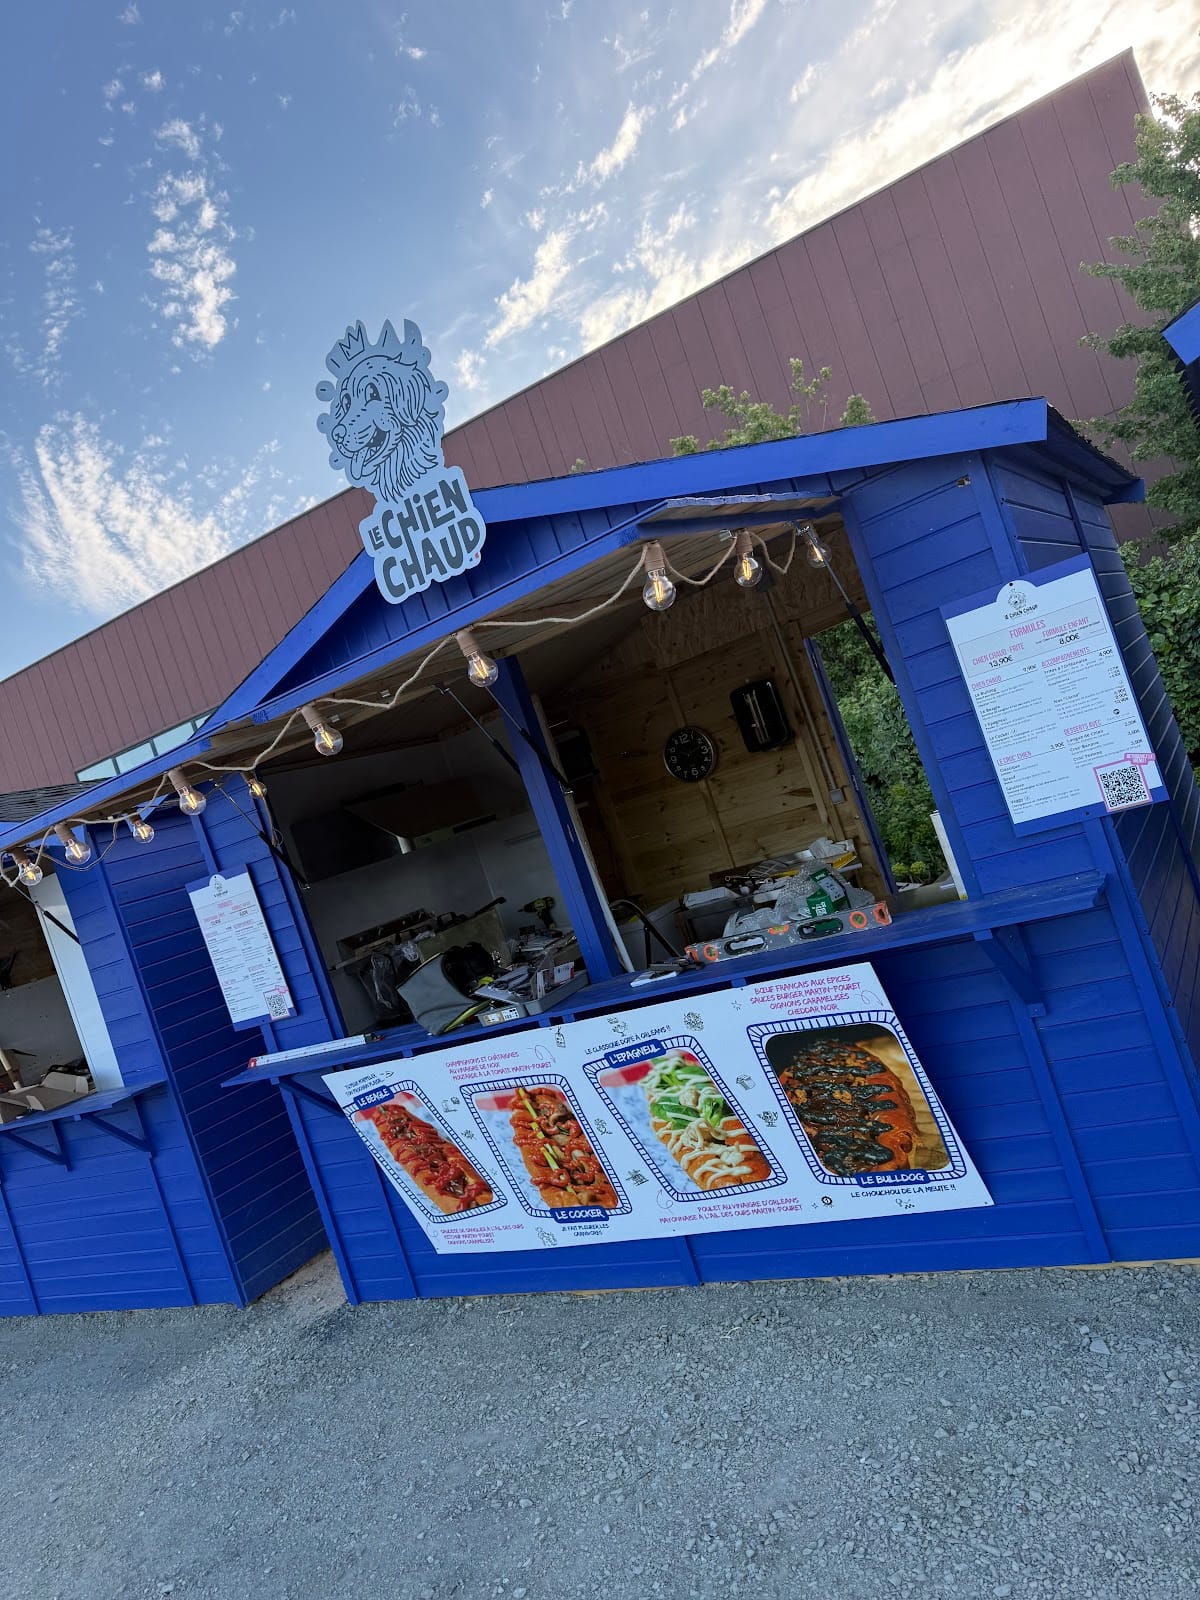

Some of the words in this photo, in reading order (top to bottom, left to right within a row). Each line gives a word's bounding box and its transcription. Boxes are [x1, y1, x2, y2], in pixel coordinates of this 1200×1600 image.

[368, 526, 384, 550] LE
[382, 518, 480, 598] CHAUD
[1009, 620, 1046, 638] FORMULES
[1042, 623, 1067, 638] FORMULE
[1068, 617, 1089, 630] ENFANT
[1060, 633, 1080, 645] 8,00€
[989, 655, 1012, 668] 13,90€
[679, 734, 690, 744] 12
[810, 978, 825, 986] AUX
[750, 994, 776, 1004] SAUCES
[777, 990, 803, 1000] BURGER
[804, 982, 861, 996] MARTIN-POURET
[770, 999, 802, 1010] OIGNONS
[787, 1006, 820, 1016] CHEDDAR
[821, 1004, 838, 1012] NOIR
[592, 1041, 620, 1052] CLASSIQUE
[446, 1058, 480, 1068] CHAMPIGNONS
[512, 1062, 552, 1072] MARTIN-POURET
[358, 1098, 367, 1107] LE
[367, 1088, 390, 1103] BEAGLE
[860, 1176, 874, 1184] LE
[876, 1173, 925, 1184] BULLDOG
[862, 1188, 900, 1197] CHOUCHOU
[555, 1210, 568, 1220] LE
[569, 1208, 605, 1218] COCKER
[660, 1214, 697, 1224] MAYONNAISE
